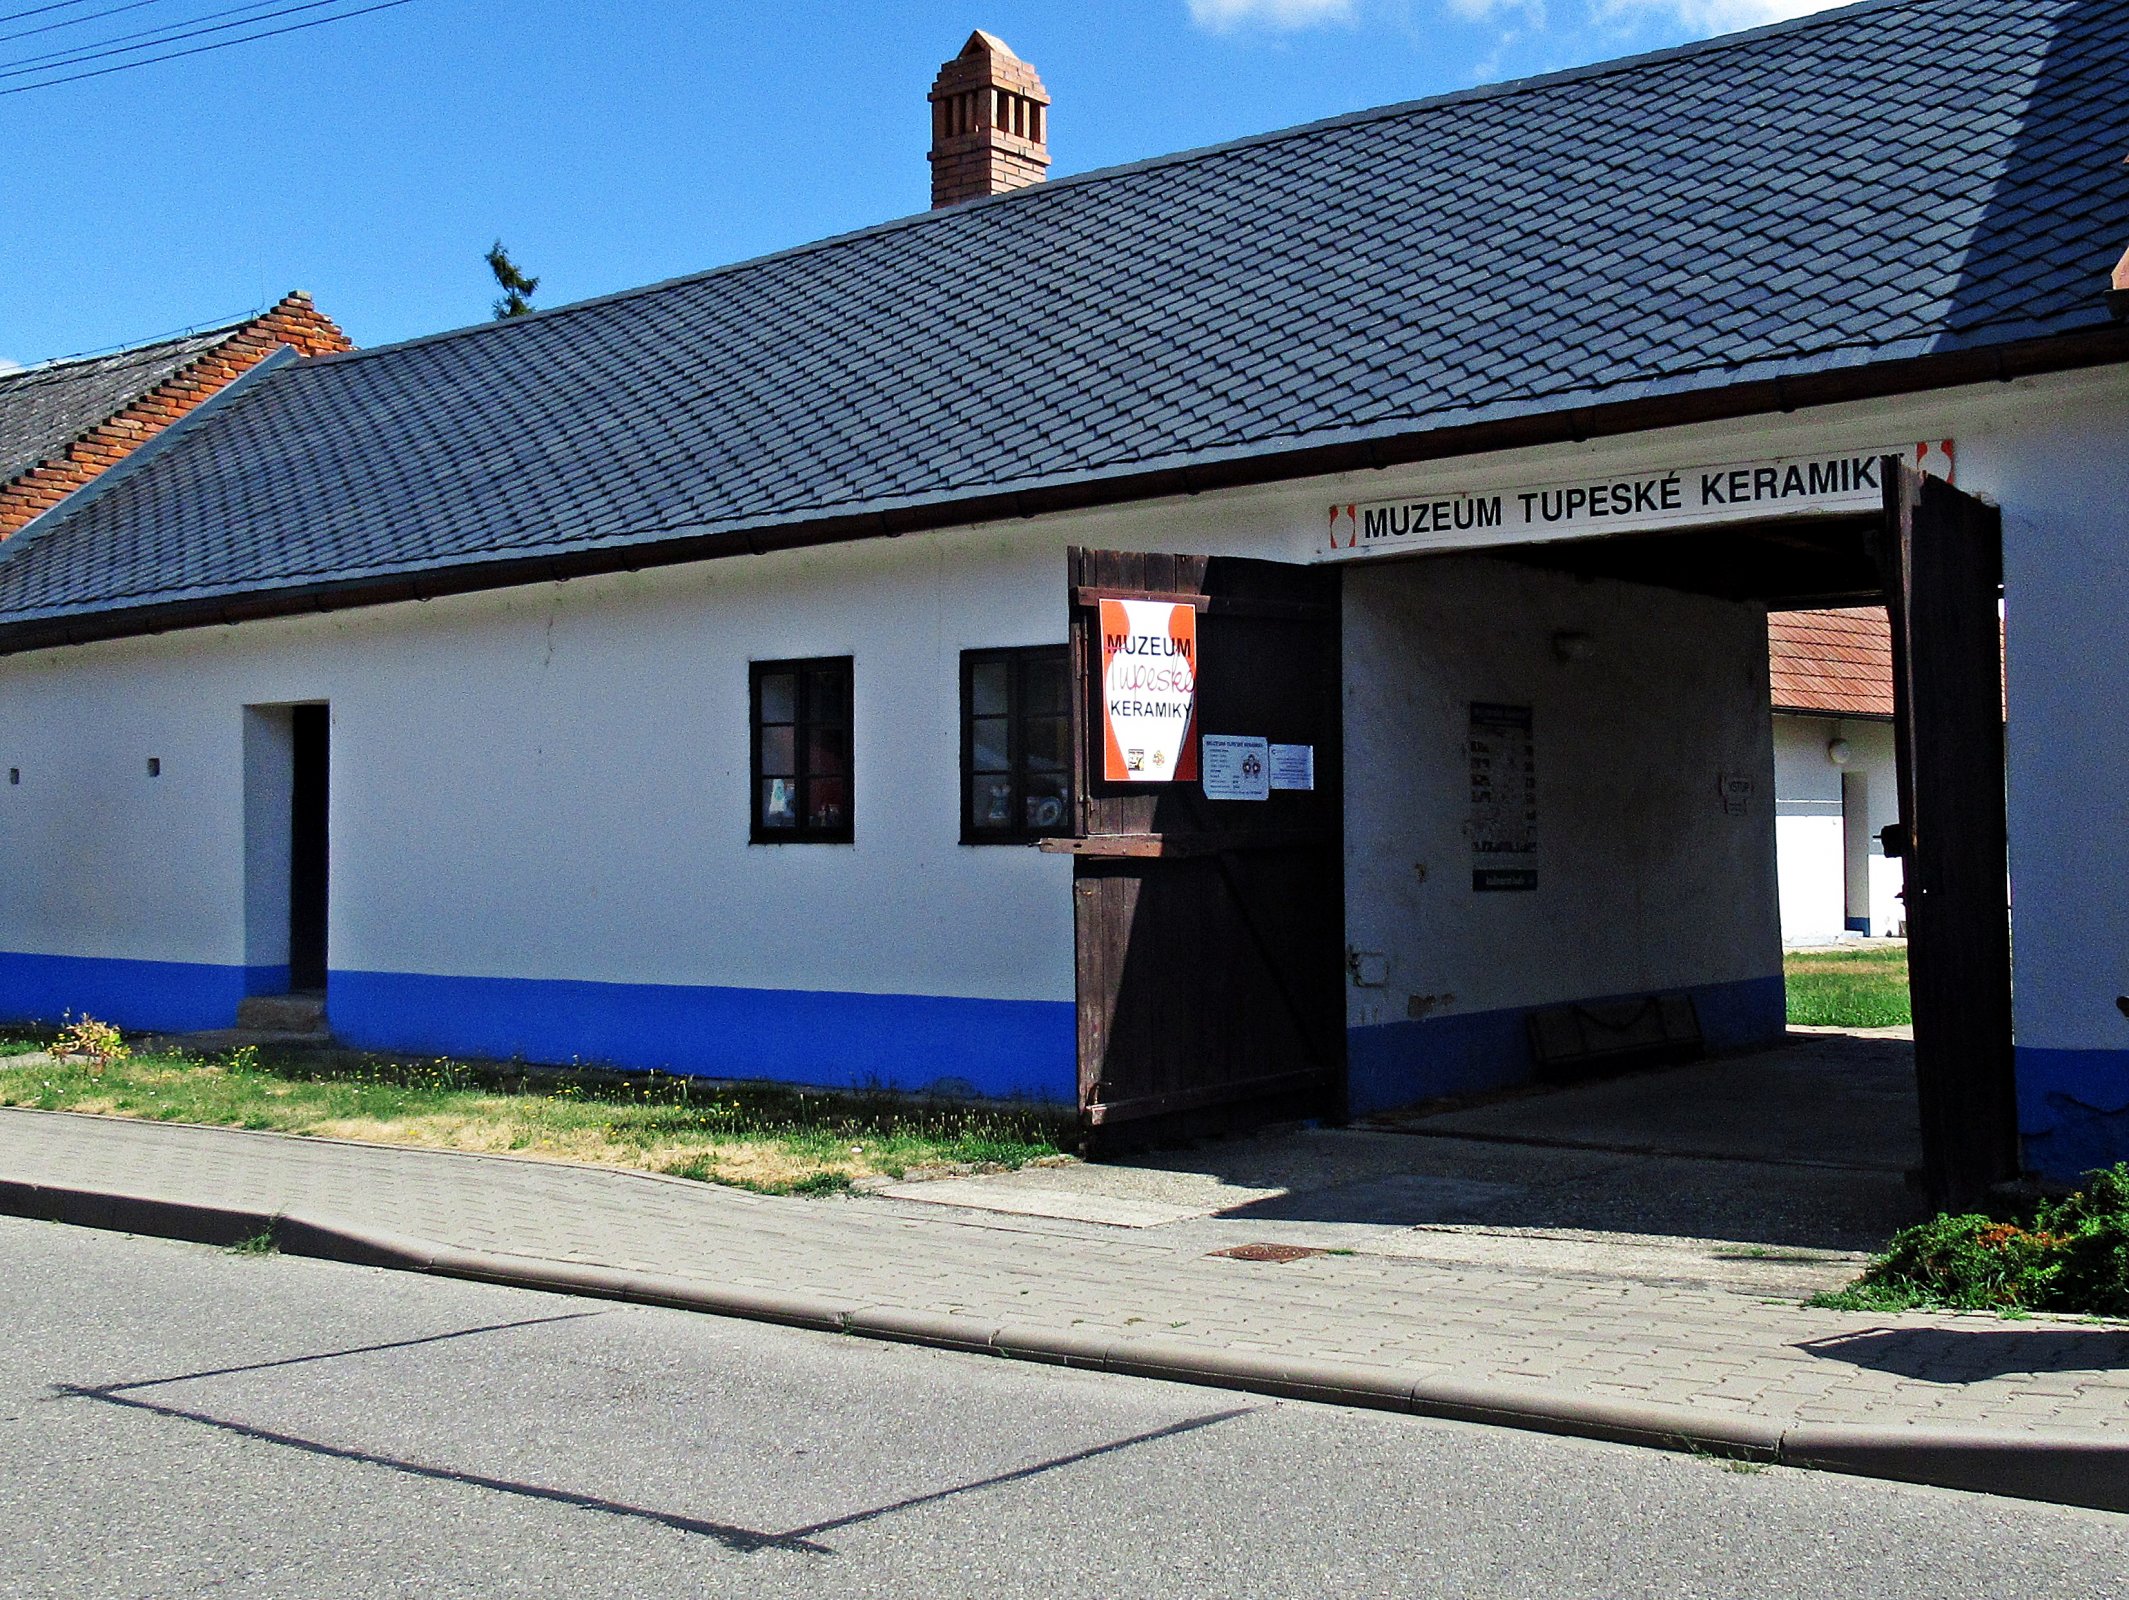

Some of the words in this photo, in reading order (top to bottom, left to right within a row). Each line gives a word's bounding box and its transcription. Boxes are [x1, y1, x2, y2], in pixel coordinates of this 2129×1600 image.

[1365, 497, 1501, 538] MUZEUM
[1518, 471, 1682, 524] TUPESKÉ
[1702, 453, 1904, 505] KERAMIK
[1107, 634, 1191, 658] MUZEUM
[1111, 700, 1192, 719] KERAMIKY
